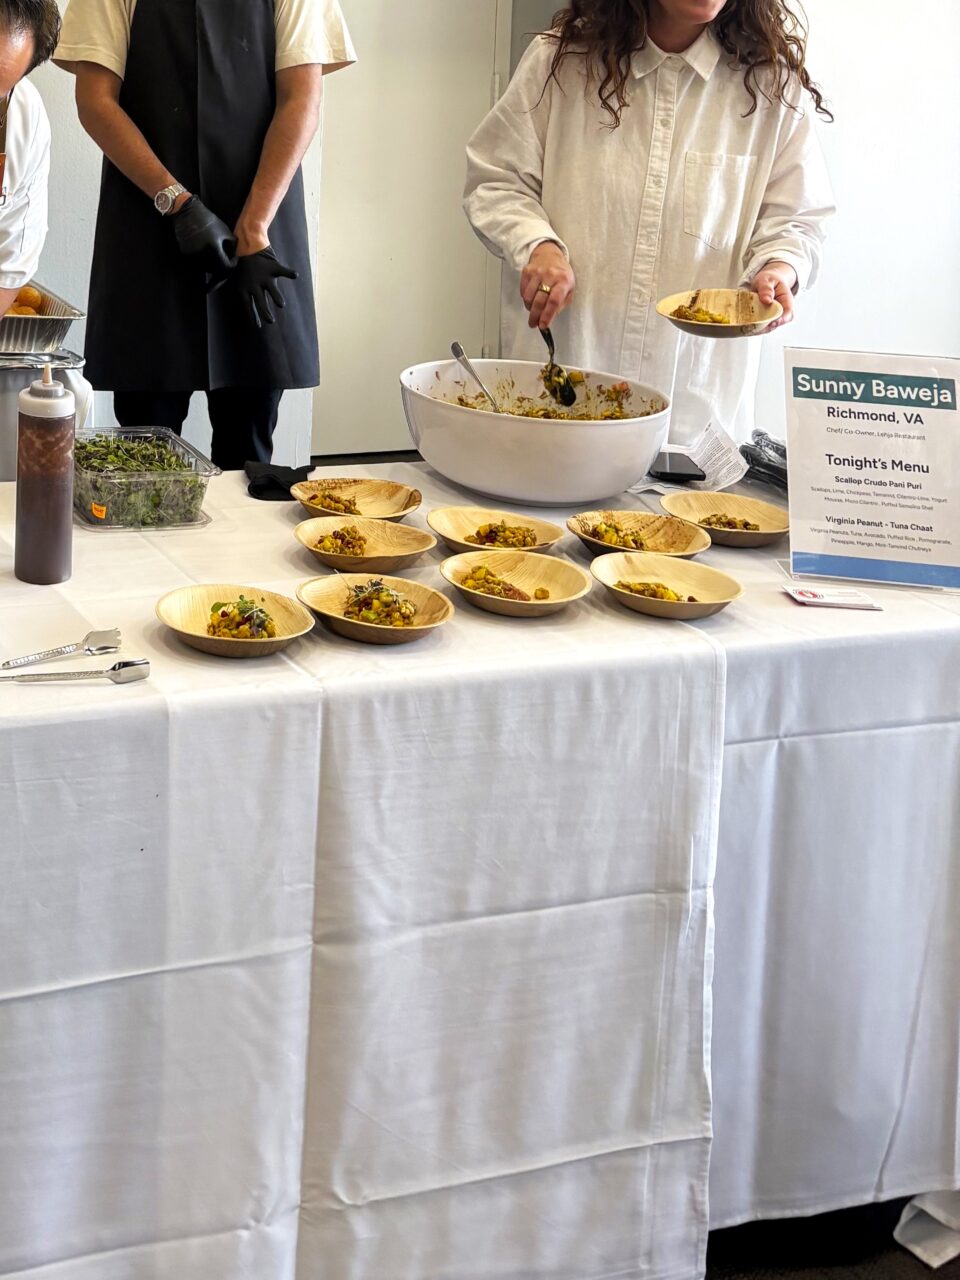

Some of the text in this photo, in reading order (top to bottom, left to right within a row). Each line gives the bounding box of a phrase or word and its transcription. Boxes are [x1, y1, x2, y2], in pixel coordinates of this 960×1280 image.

[797, 373, 952, 406] Sunny Baweja
[827, 406, 924, 425] Richmond, VA
[825, 453, 929, 473] Tonight's Menu
[834, 475, 862, 486] Scallop
[863, 478, 887, 487] Crudo
[889, 480, 905, 488] Pani
[825, 516, 855, 525] Virginia
[856, 518, 883, 528] Peanut
[890, 521, 908, 530] Tuna
[910, 523, 933, 532] Chaat
